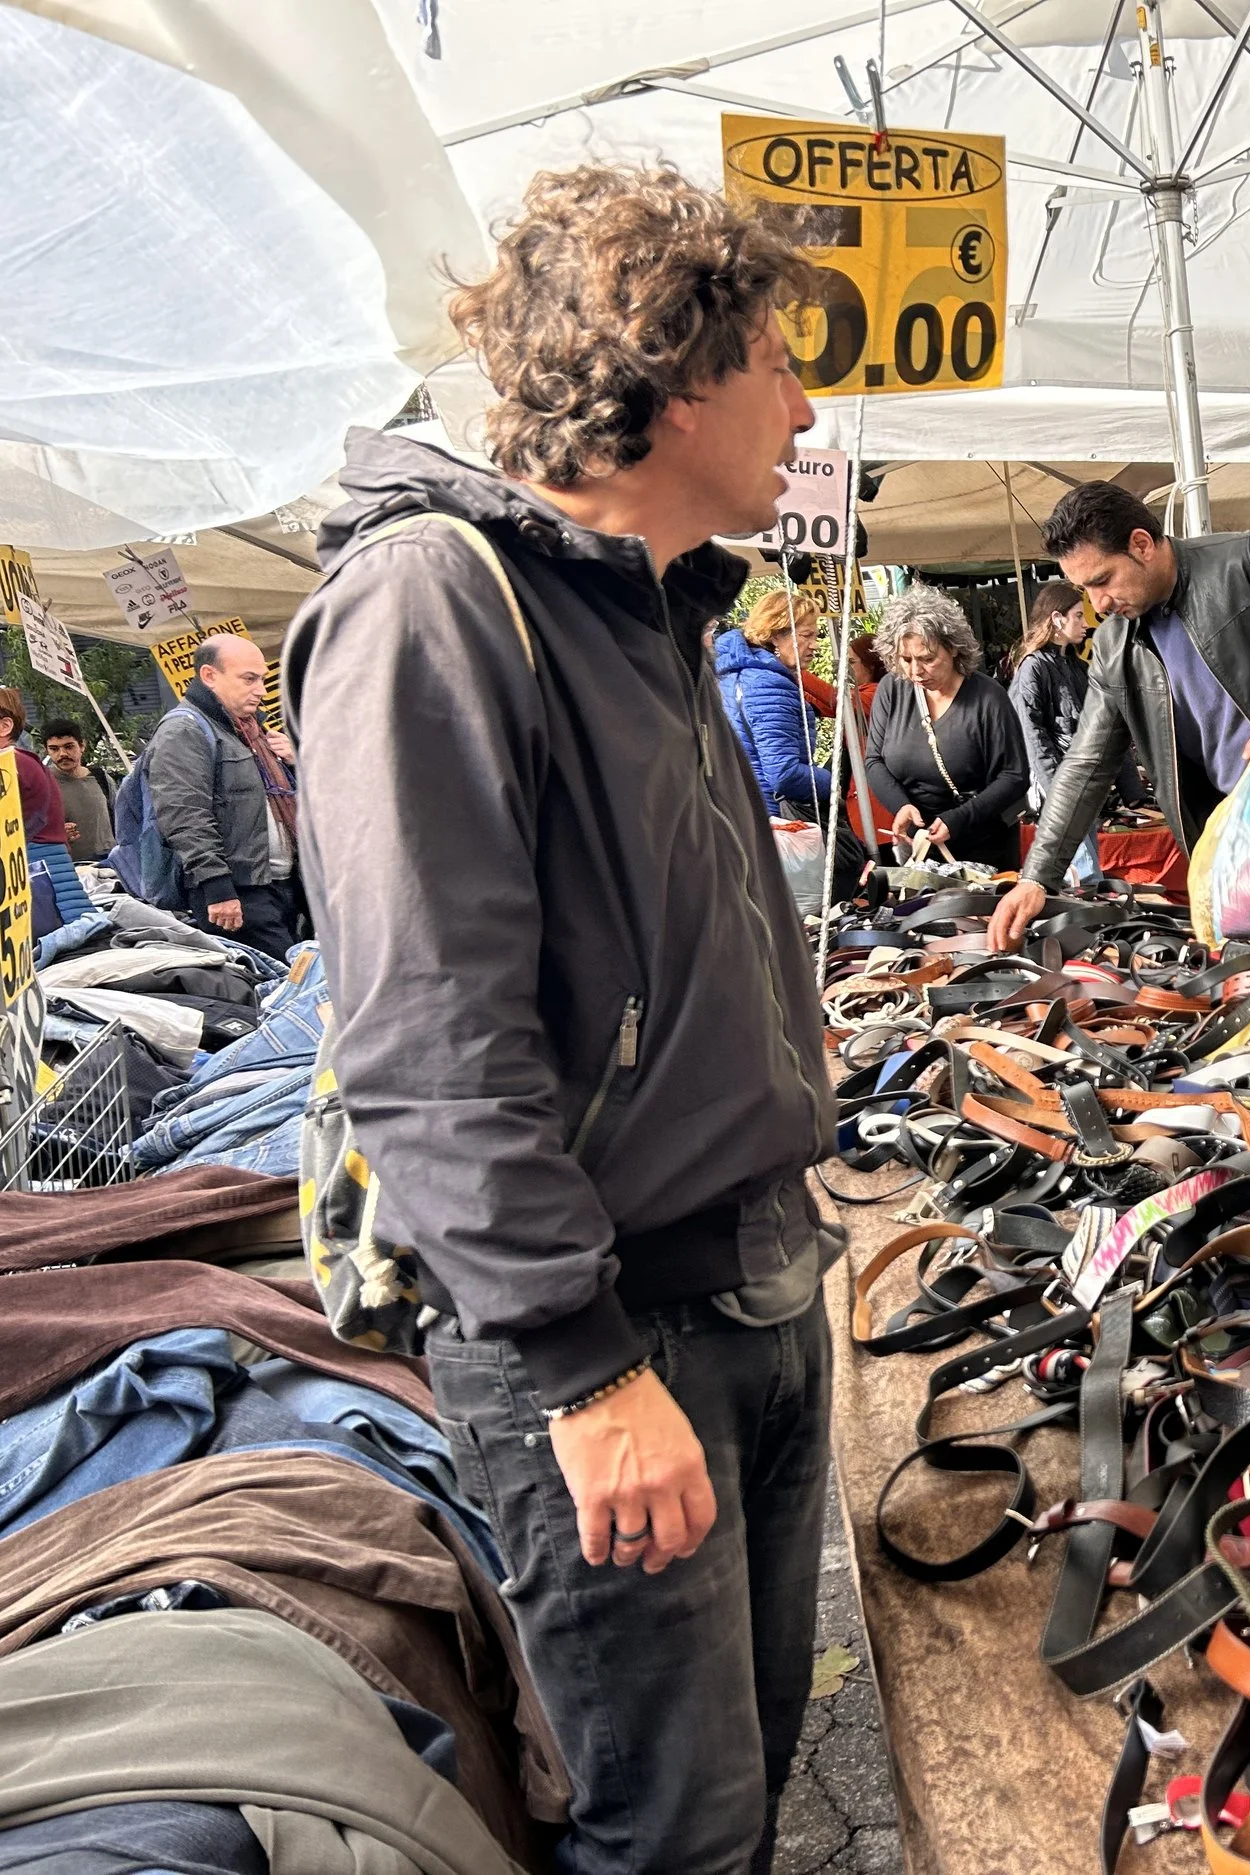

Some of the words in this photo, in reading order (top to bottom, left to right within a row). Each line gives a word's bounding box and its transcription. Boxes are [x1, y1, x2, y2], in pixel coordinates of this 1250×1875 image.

[763, 138, 976, 193] OFFERTA
[957, 230, 983, 275] €
[111, 566, 136, 580] GEOX
[164, 661, 174, 675] 1
